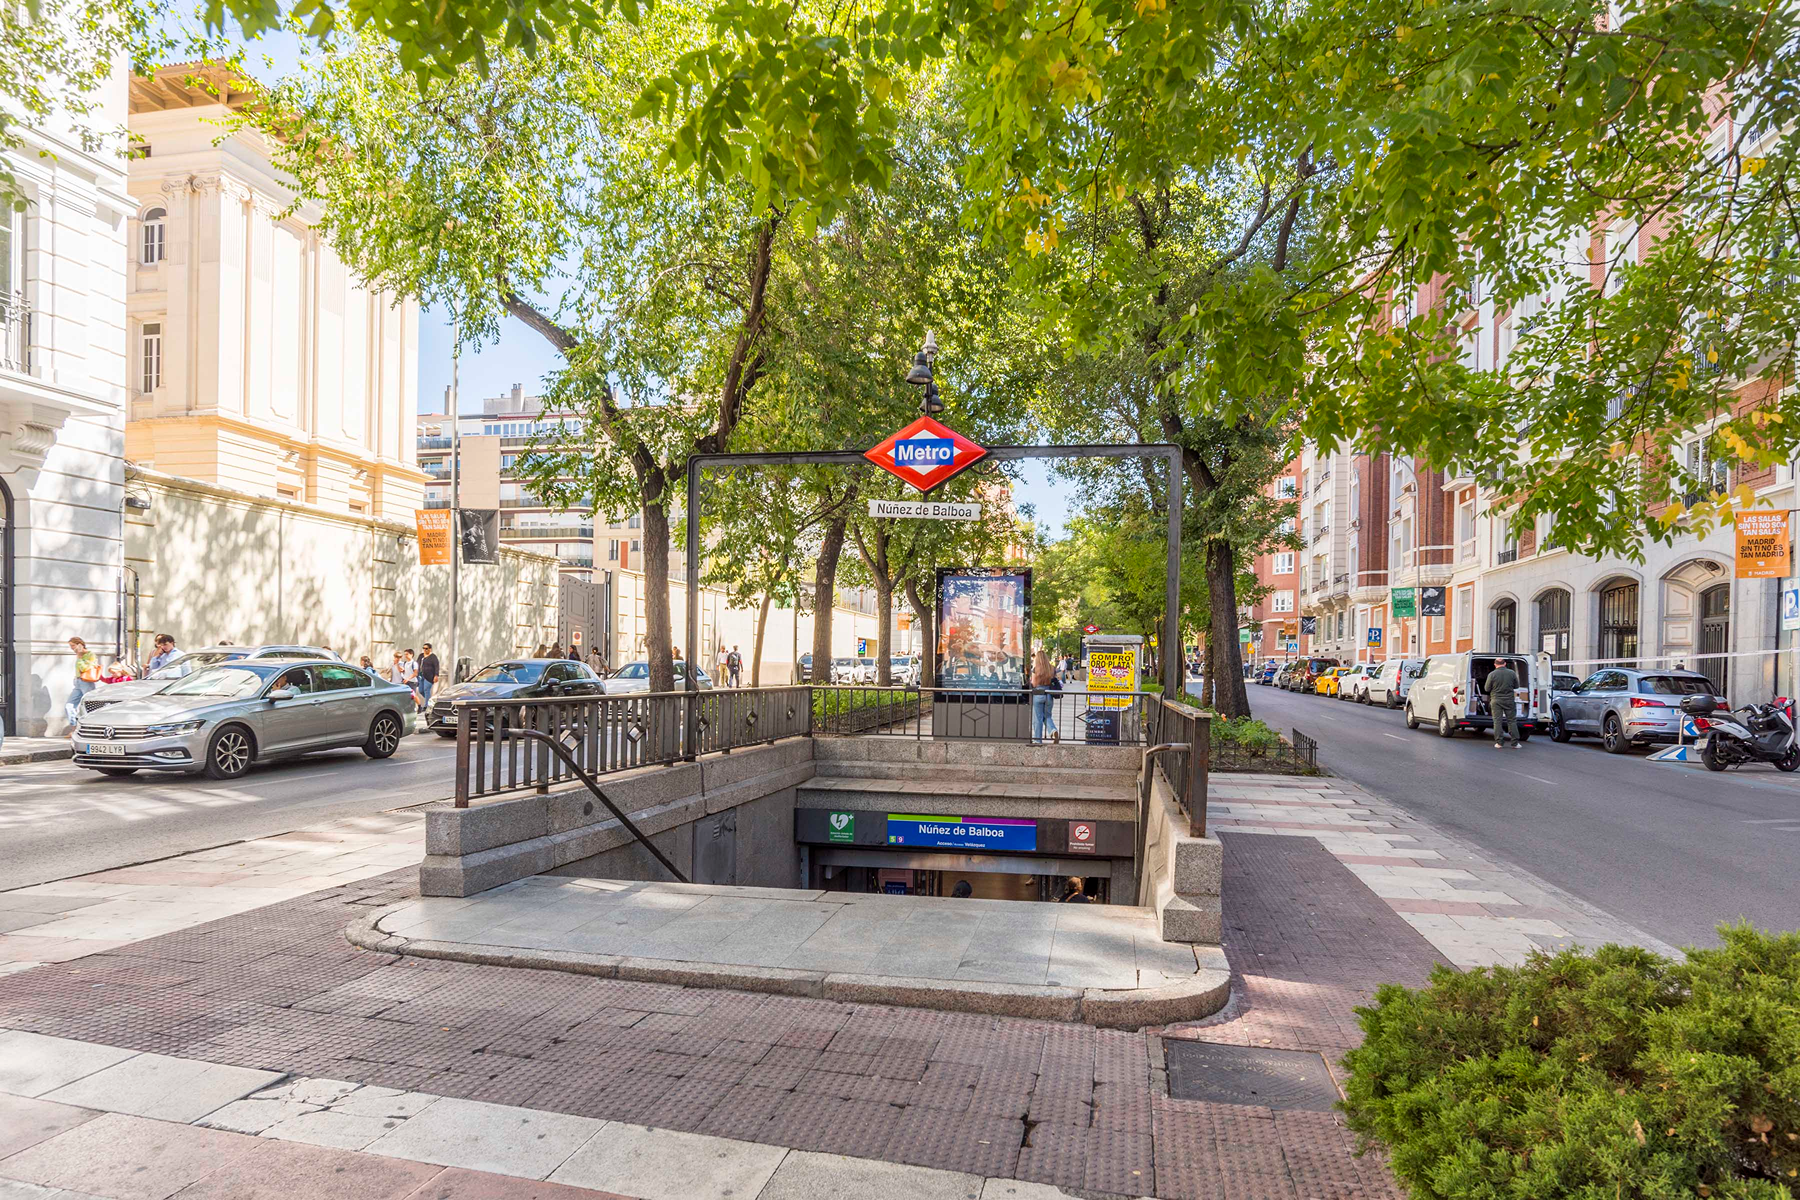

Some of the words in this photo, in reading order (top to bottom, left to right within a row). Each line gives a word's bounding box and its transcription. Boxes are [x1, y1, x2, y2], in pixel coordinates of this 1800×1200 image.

[898, 445, 951, 461] Metro
[877, 503, 912, 515] Núñez
[915, 505, 929, 516] de
[932, 505, 972, 517] Balboa
[1758, 515, 1782, 523] SALAS
[1738, 522, 1751, 530] SIN
[1091, 653, 1131, 662] COMPRO
[918, 824, 951, 835] Núñez
[953, 826, 966, 836] de
[968, 827, 1004, 838] Balboa
